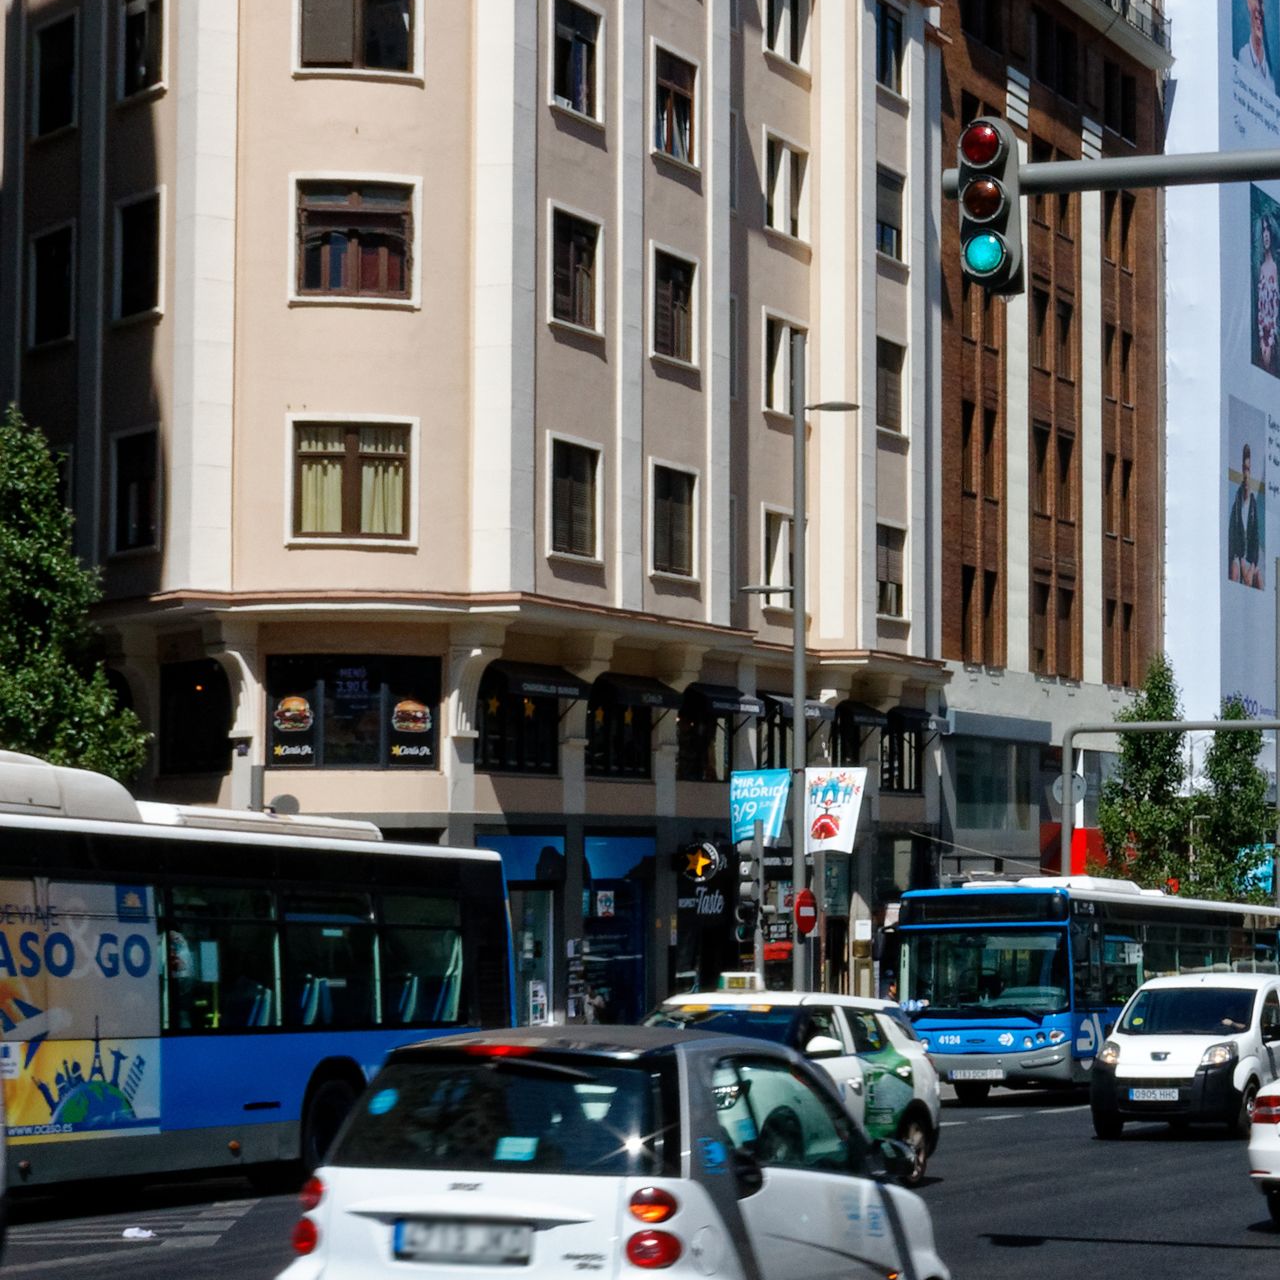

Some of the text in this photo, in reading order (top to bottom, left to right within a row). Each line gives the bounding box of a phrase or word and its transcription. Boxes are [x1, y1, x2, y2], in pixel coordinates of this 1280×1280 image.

[732, 776, 765, 787] MIRA
[696, 885, 725, 915] Taste
[96, 933, 152, 978] GO
[938, 1034, 961, 1045] 4124
